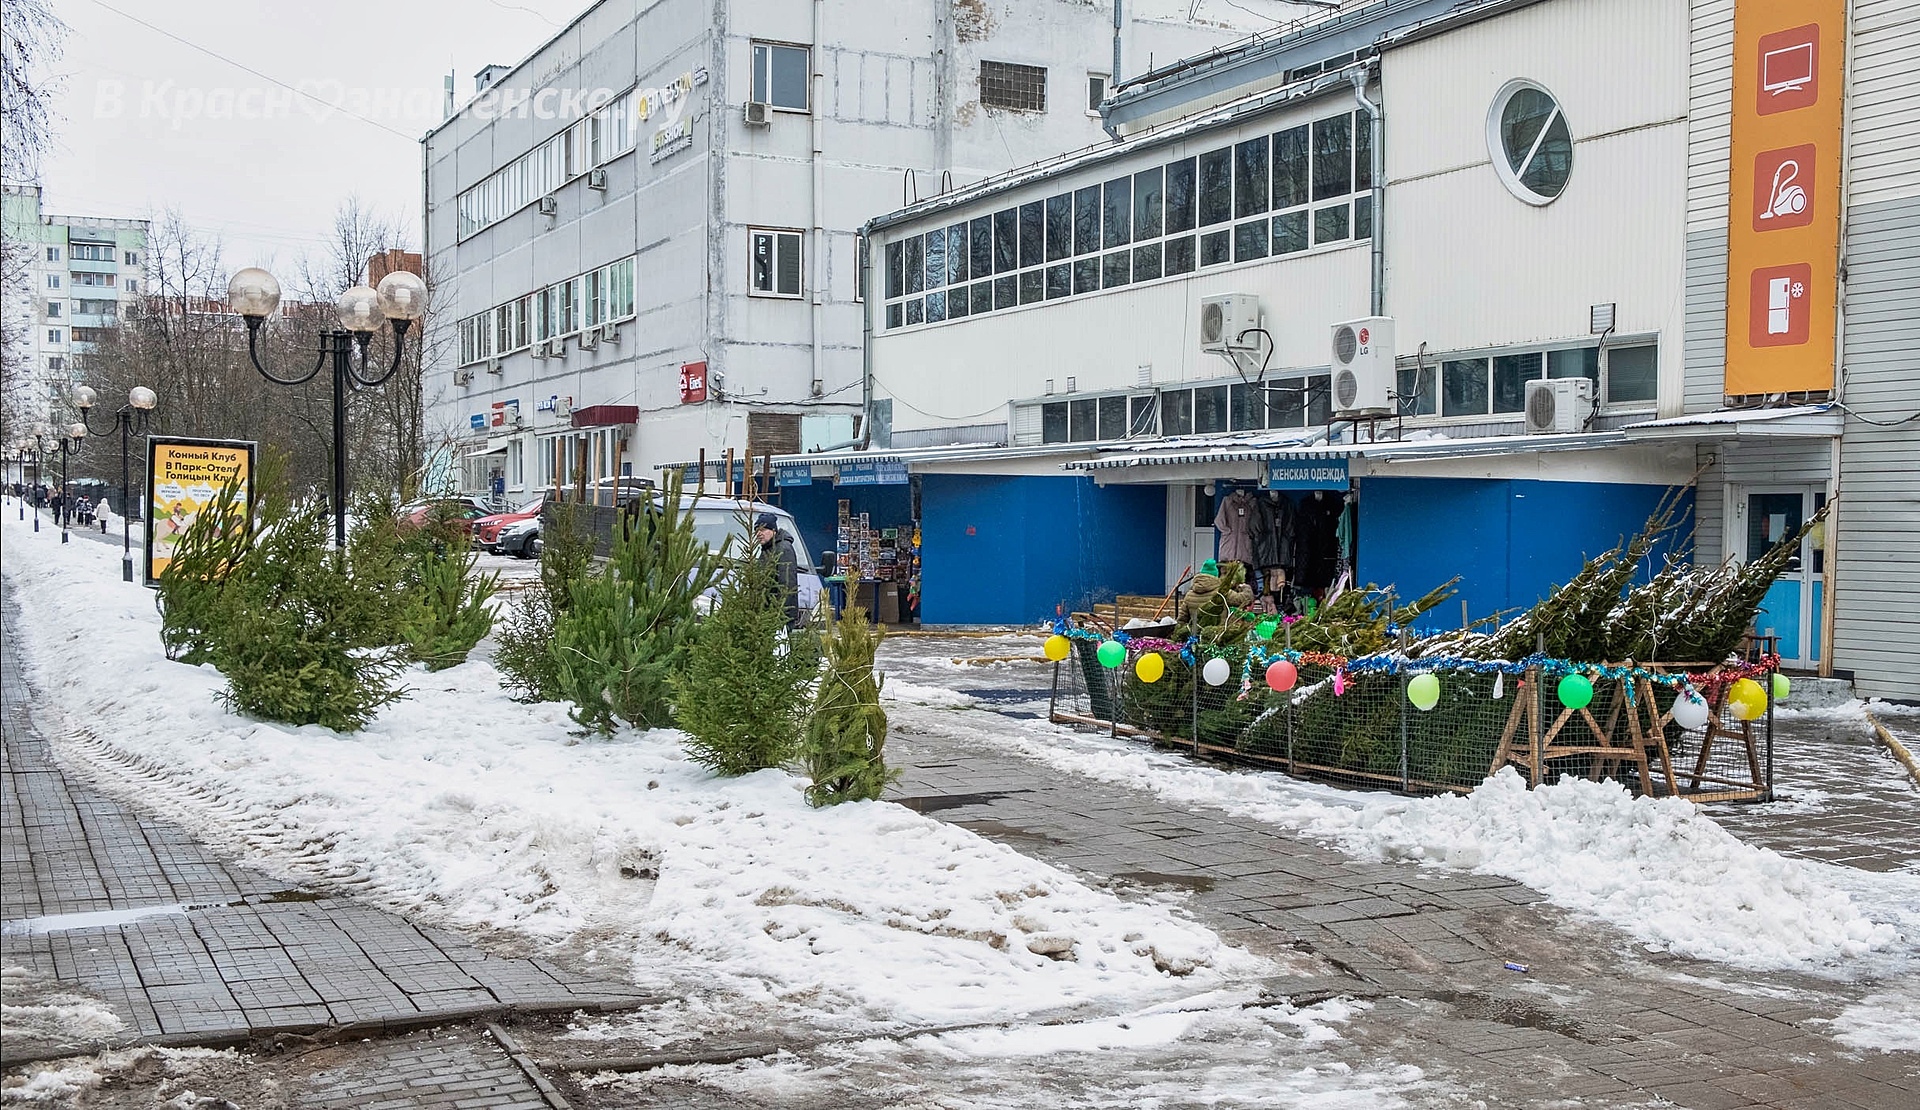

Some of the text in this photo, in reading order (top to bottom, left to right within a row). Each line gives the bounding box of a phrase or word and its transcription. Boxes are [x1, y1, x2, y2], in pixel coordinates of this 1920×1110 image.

[1360, 347, 1368, 355] LG
[168, 449, 237, 463] Конный Клуб
[165, 461, 172, 470] В
[165, 471, 238, 484] Голицын Клу
[1272, 468, 1346, 482] ЖЕНСКАЯ ОДЕЖДА
